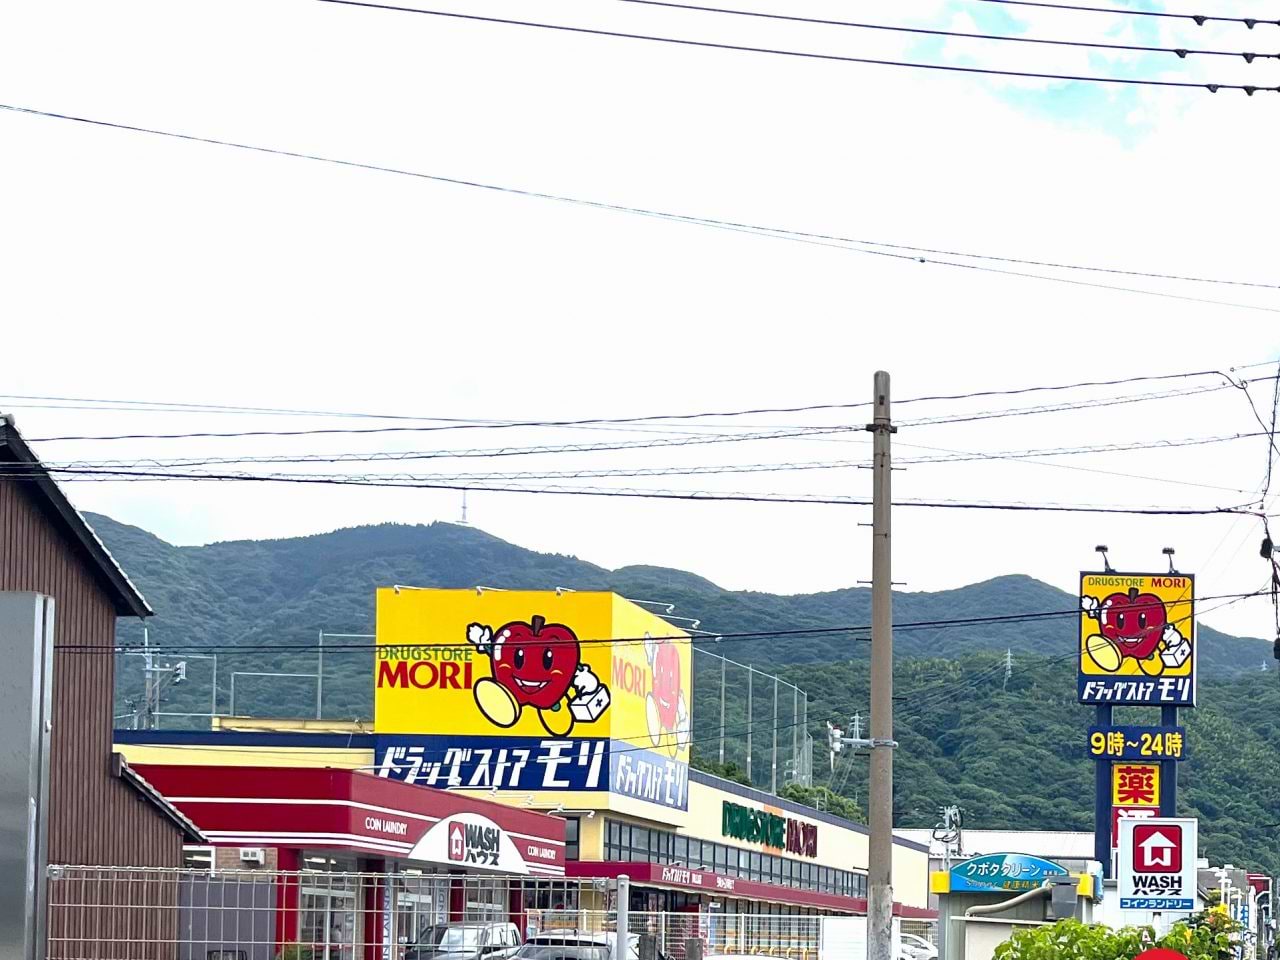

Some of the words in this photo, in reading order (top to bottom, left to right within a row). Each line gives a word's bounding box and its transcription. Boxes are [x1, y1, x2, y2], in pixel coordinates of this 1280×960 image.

[1088, 577, 1144, 587] DRUGSTORE
[1151, 578, 1186, 588] MORI
[378, 645, 473, 661] DRUGSTORE
[377, 661, 473, 689] MORI
[612, 656, 646, 697] MORI
[1118, 766, 1155, 804] 薬
[365, 816, 382, 832] COIN
[465, 824, 500, 852] WASH
[464, 849, 500, 866] ハウス
[967, 862, 1041, 877] クボタクリーン
[1132, 875, 1183, 889] WASH
[1132, 888, 1183, 896] ハウス
[1121, 899, 1193, 909] コインランドリー
